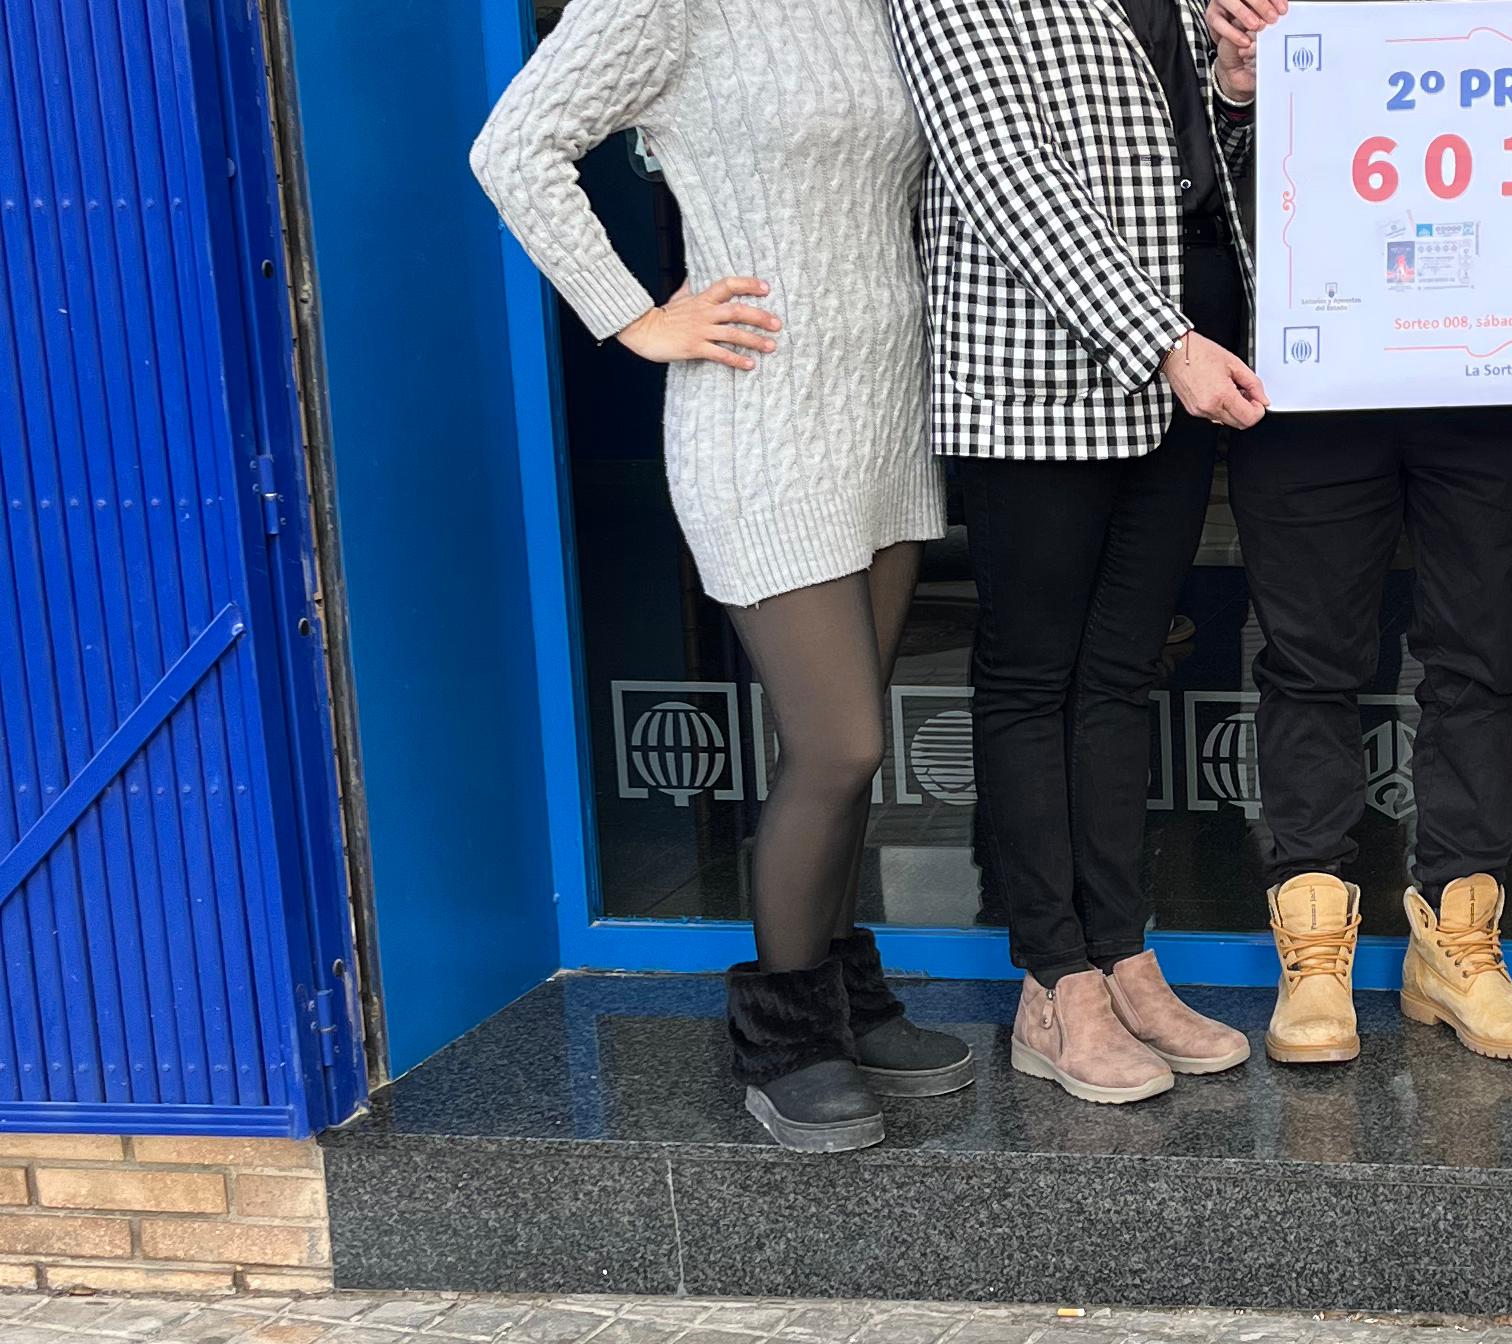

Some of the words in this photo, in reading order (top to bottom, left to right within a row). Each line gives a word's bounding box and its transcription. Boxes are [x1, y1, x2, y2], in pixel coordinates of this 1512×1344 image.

[1386, 69, 1445, 111] 2º
[1394, 317, 1440, 331] Sorteo
[1443, 315, 1473, 331] 008,
[1465, 364, 1480, 377] La
[1484, 363, 1512, 377] Sort
